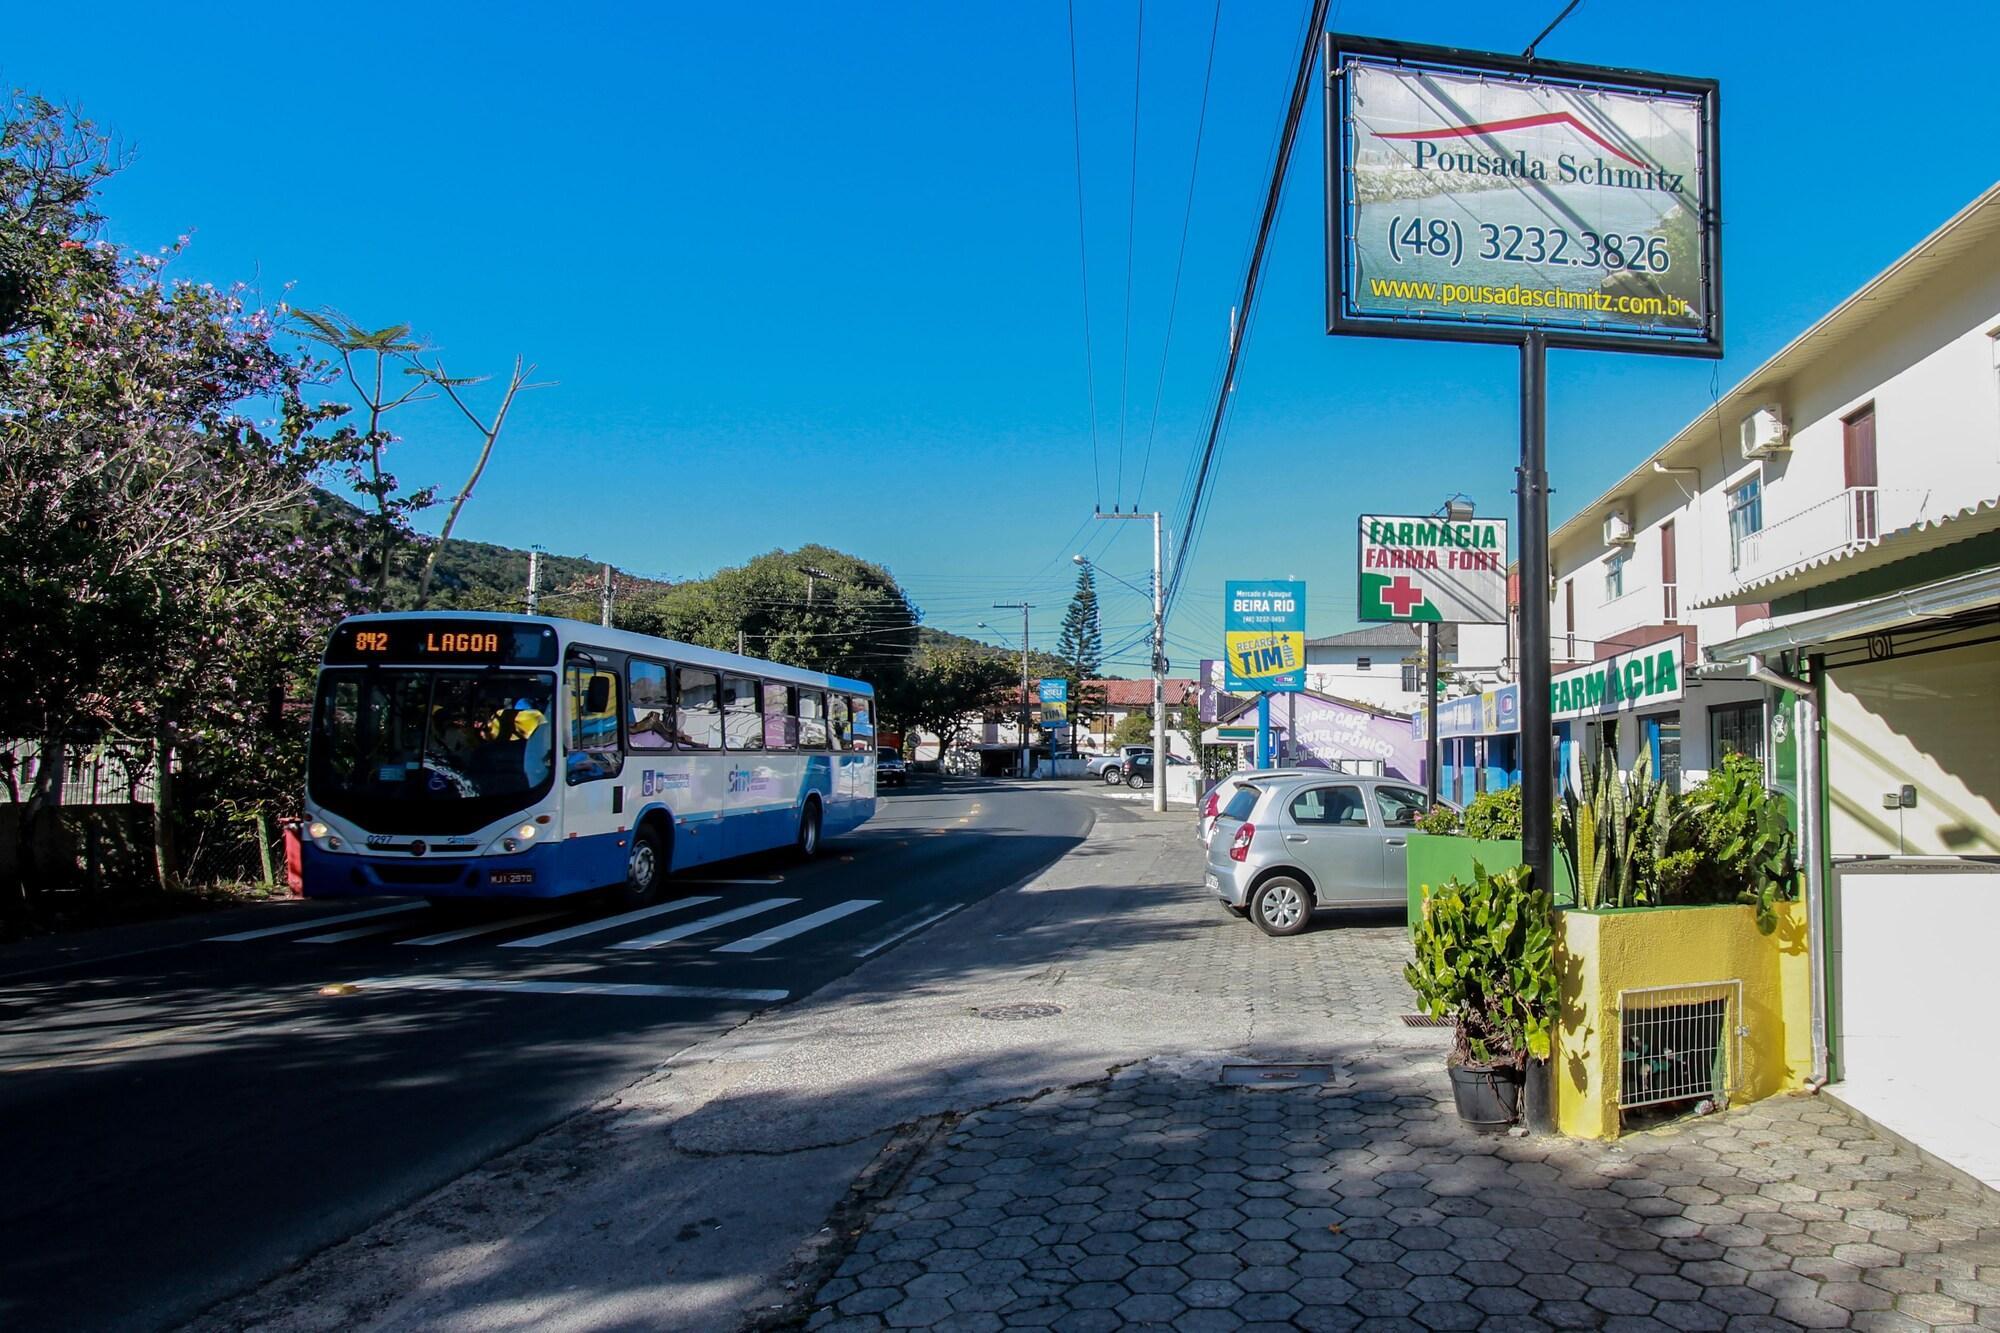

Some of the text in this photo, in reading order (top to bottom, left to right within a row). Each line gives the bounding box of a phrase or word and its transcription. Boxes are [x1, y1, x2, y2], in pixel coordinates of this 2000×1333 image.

[1410, 139, 1684, 194] Pousada Schmitz
[1387, 215, 1671, 273] (48) 3232.3826
[1369, 277, 1690, 316] www.pousadaschmitz.com.br
[1365, 548, 1501, 571] FARMA FORT
[1233, 599, 1296, 613] BEIRA RIO
[356, 632, 498, 652] 842 LAGOA
[1236, 636, 1279, 652] RECARGA
[1238, 646, 1284, 675] TIM
[1283, 644, 1296, 668] CHIP
[367, 835, 393, 845] 0297
